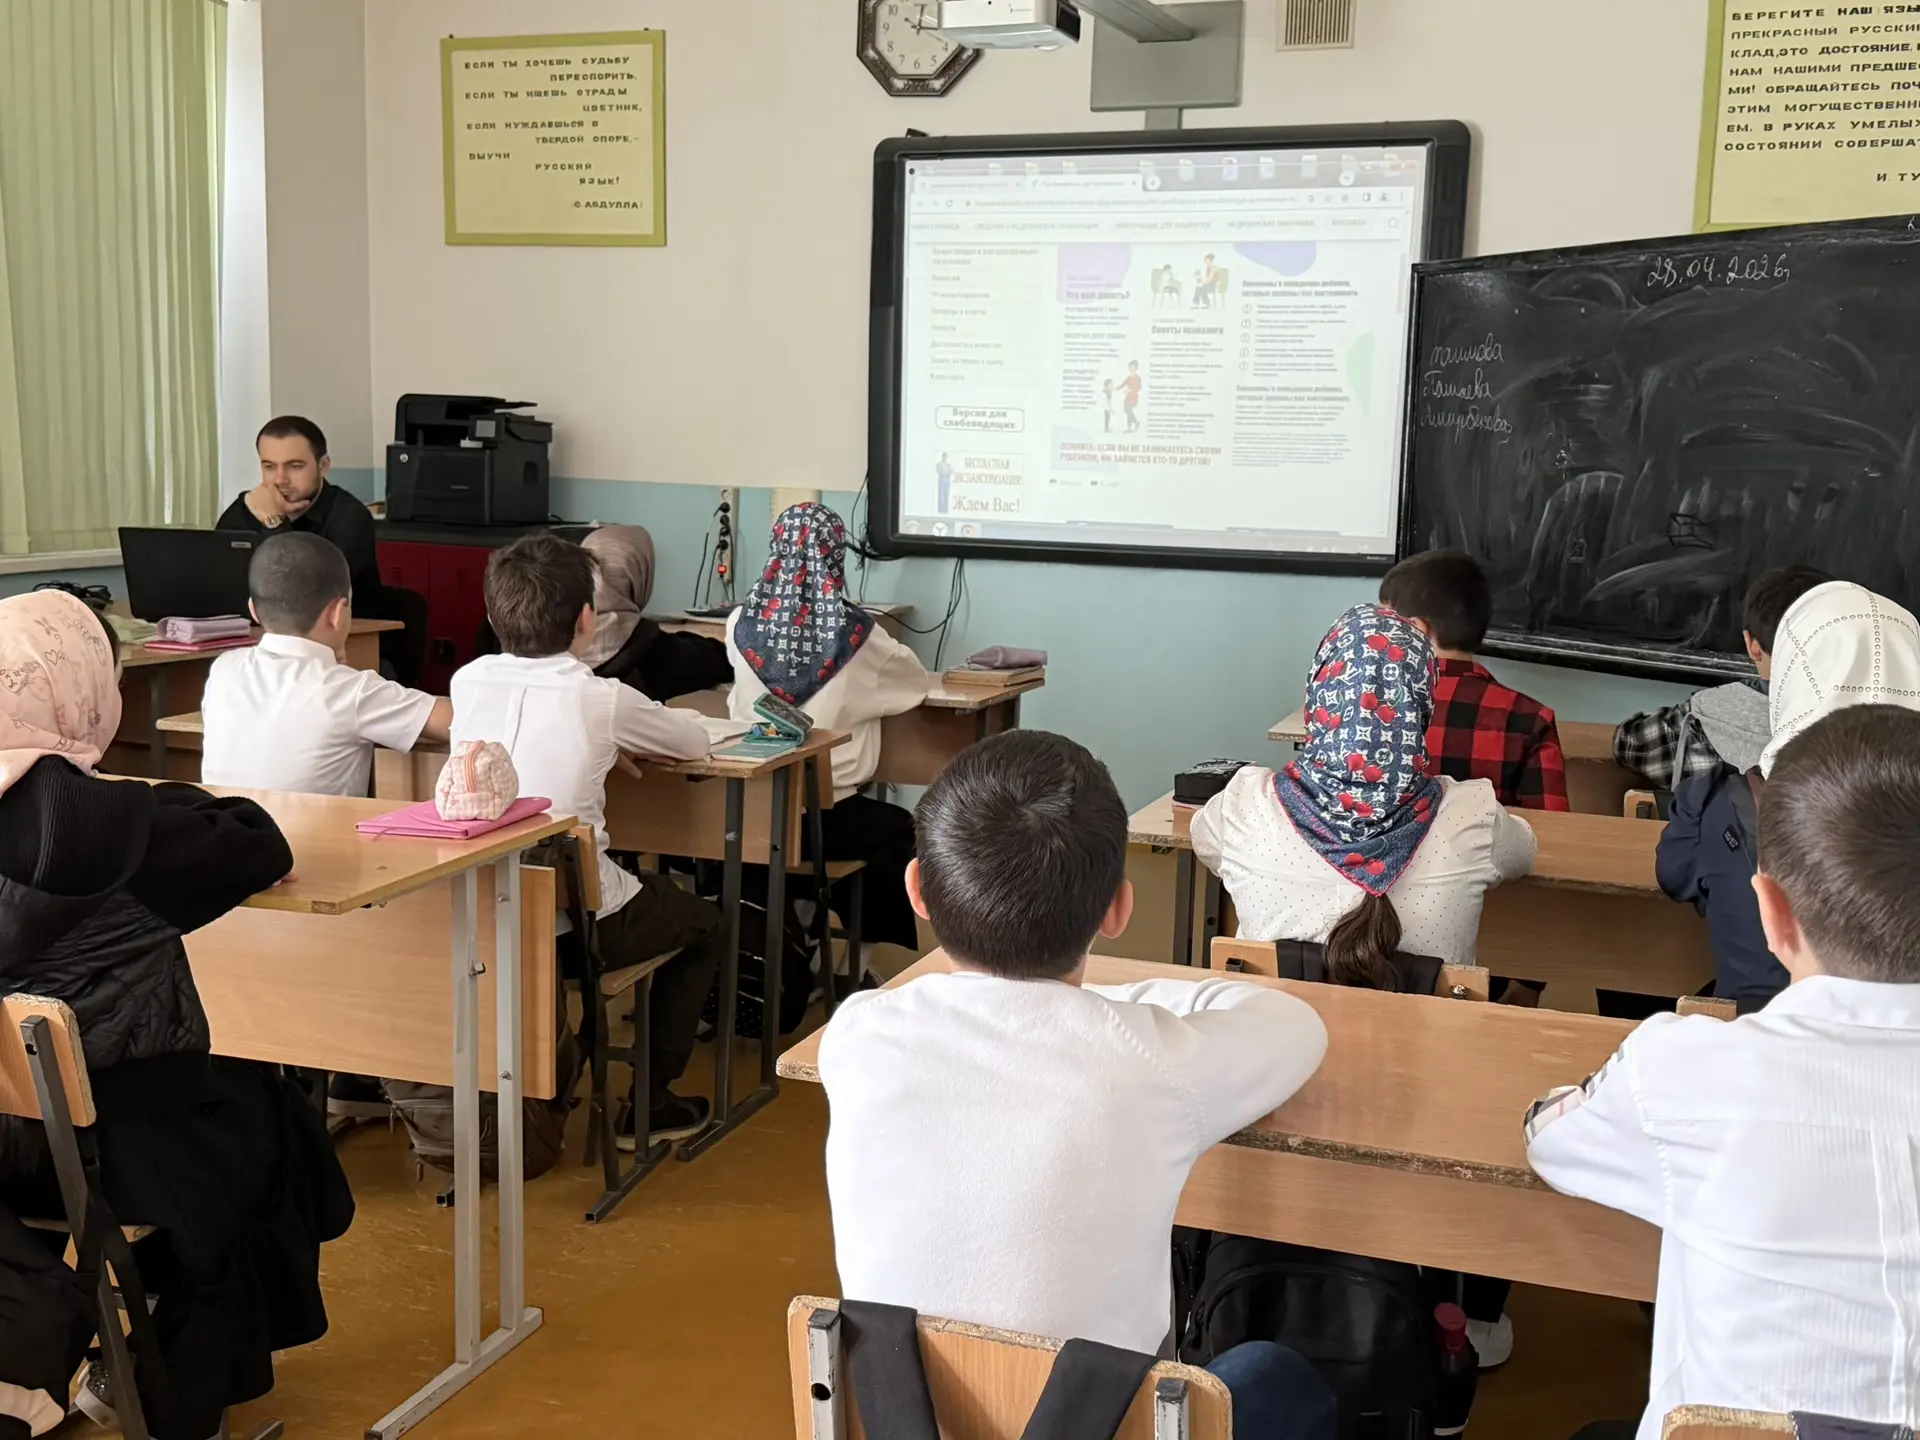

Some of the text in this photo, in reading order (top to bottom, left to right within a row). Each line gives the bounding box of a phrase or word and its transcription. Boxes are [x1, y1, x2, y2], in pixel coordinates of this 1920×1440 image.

[889, 4, 899, 16] 10
[1732, 9, 1825, 21] БЕРЕГИТЕ
[1837, 7, 1873, 16] НАШ
[883, 23, 890, 32] 9
[1731, 26, 1838, 40] ПРЕКРАСНЫЙ
[888, 41, 894, 53] 8
[465, 57, 630, 69] ЕСЛИ ТЫ ХОЧЕШЬ СУДЬБУ
[899, 54, 905, 65] 7
[914, 57, 920, 69] 6
[929, 55, 937, 67] 5
[1729, 67, 1762, 76] НАМ
[1774, 64, 1841, 75] НАШИМИ
[527, 89, 567, 98] ИЩЕШЬ
[577, 88, 627, 96] ОТРАДЫ
[1728, 85, 1755, 95] МИ!
[1765, 81, 1880, 94] ОБРАЩАЙТЕСЬ
[1727, 99, 1920, 114] ЭТИМ МОГУЩЕСТВЕНН
[505, 121, 584, 130] НУЖДАЕШЬСЯ
[1783, 121, 1836, 132] РУКАХ
[536, 134, 584, 144] ТВЕРДОЙ
[1725, 141, 1822, 151] СОСТОЯНИИ
[535, 162, 592, 171] РУССКИЙ
[580, 177, 620, 185] ЯЗЫК!
[953, 407, 1007, 419] Версия для
[943, 419, 1015, 429] слабовидящих
[953, 494, 1020, 513] Ждем Вас!
